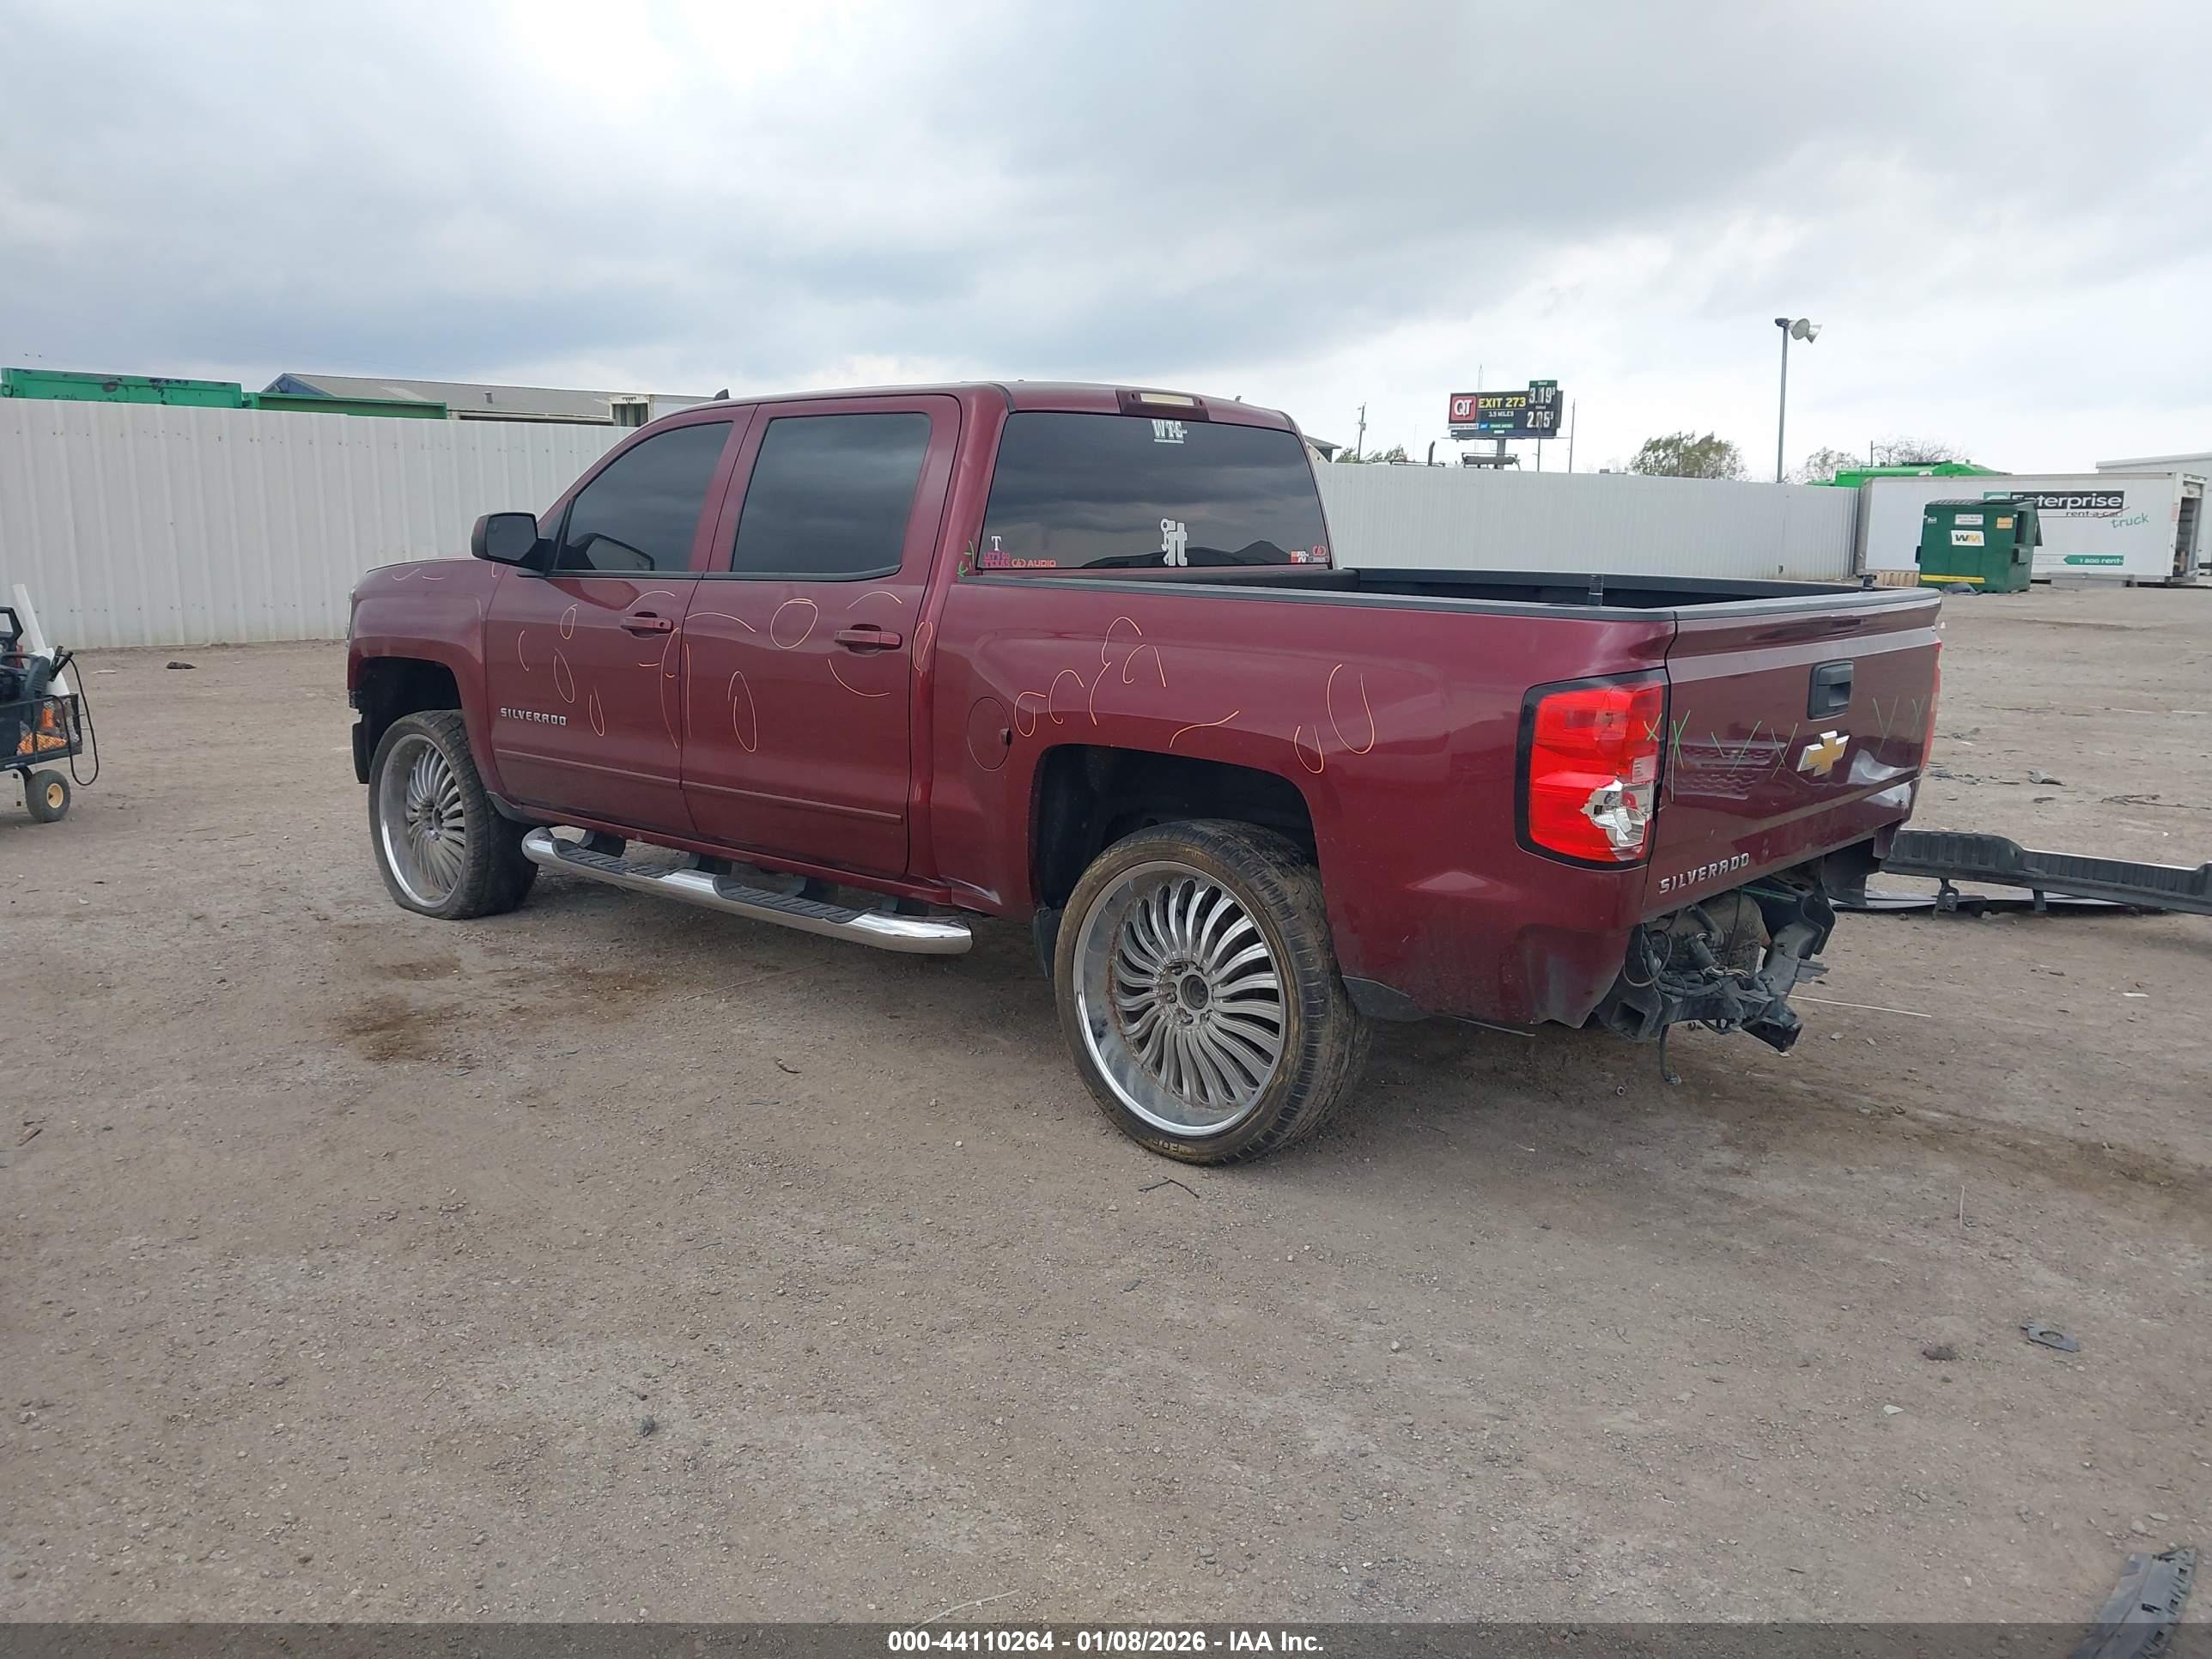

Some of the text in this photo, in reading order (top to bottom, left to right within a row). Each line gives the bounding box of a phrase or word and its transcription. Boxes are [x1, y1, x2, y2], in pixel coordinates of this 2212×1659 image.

[1454, 399, 1474, 416] QT
[1478, 396, 1526, 408] EXIT 273
[2012, 493, 2123, 509] Eterprise
[2111, 513, 2149, 529] truck
[991, 535, 1002, 551] T
[1955, 534, 1981, 543] WM
[1027, 559, 1056, 568] AUDIO
[501, 707, 567, 726] SILVERADO
[1659, 852, 1750, 895] SILVERADO
